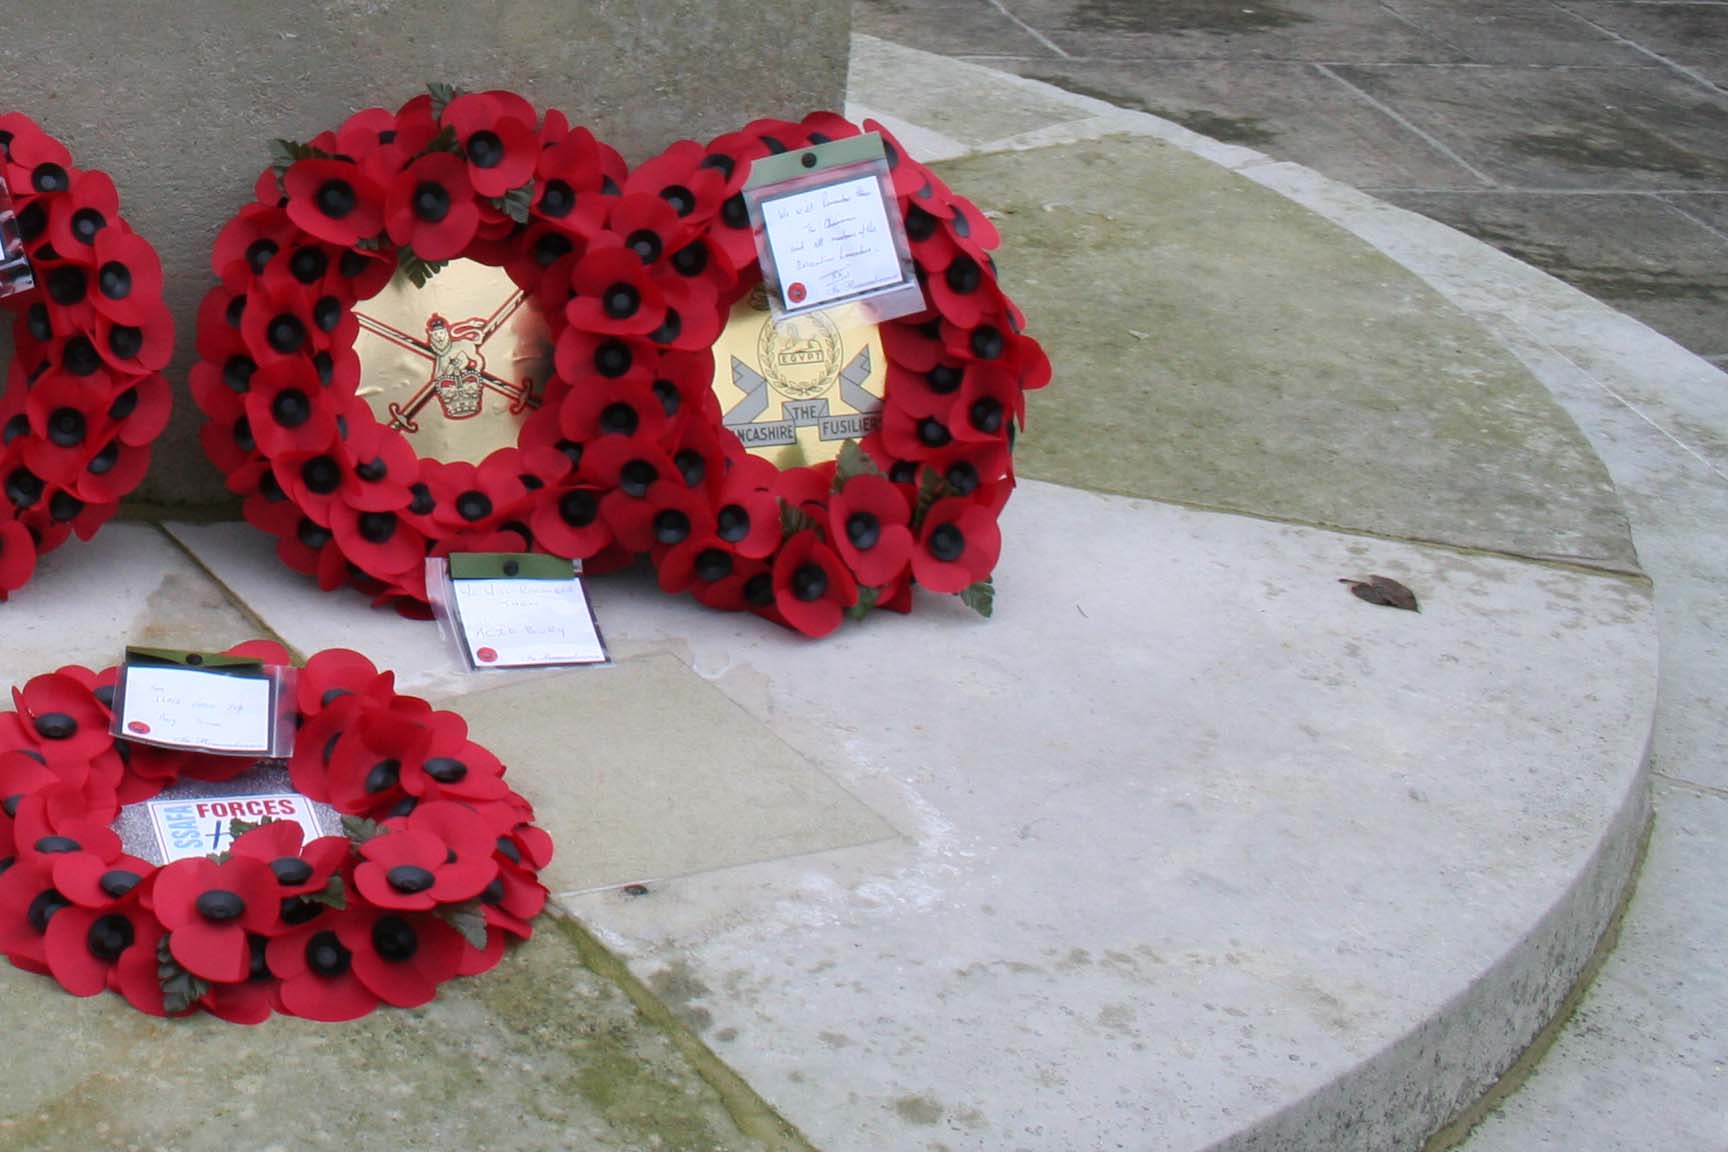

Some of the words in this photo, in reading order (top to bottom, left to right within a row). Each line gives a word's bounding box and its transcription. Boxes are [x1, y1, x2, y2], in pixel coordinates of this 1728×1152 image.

[782, 352, 821, 363] EGYPT
[792, 405, 817, 419] THE
[823, 416, 880, 435] FUSILIER
[195, 798, 297, 819] FORCES
[163, 804, 204, 849] SSAFA
